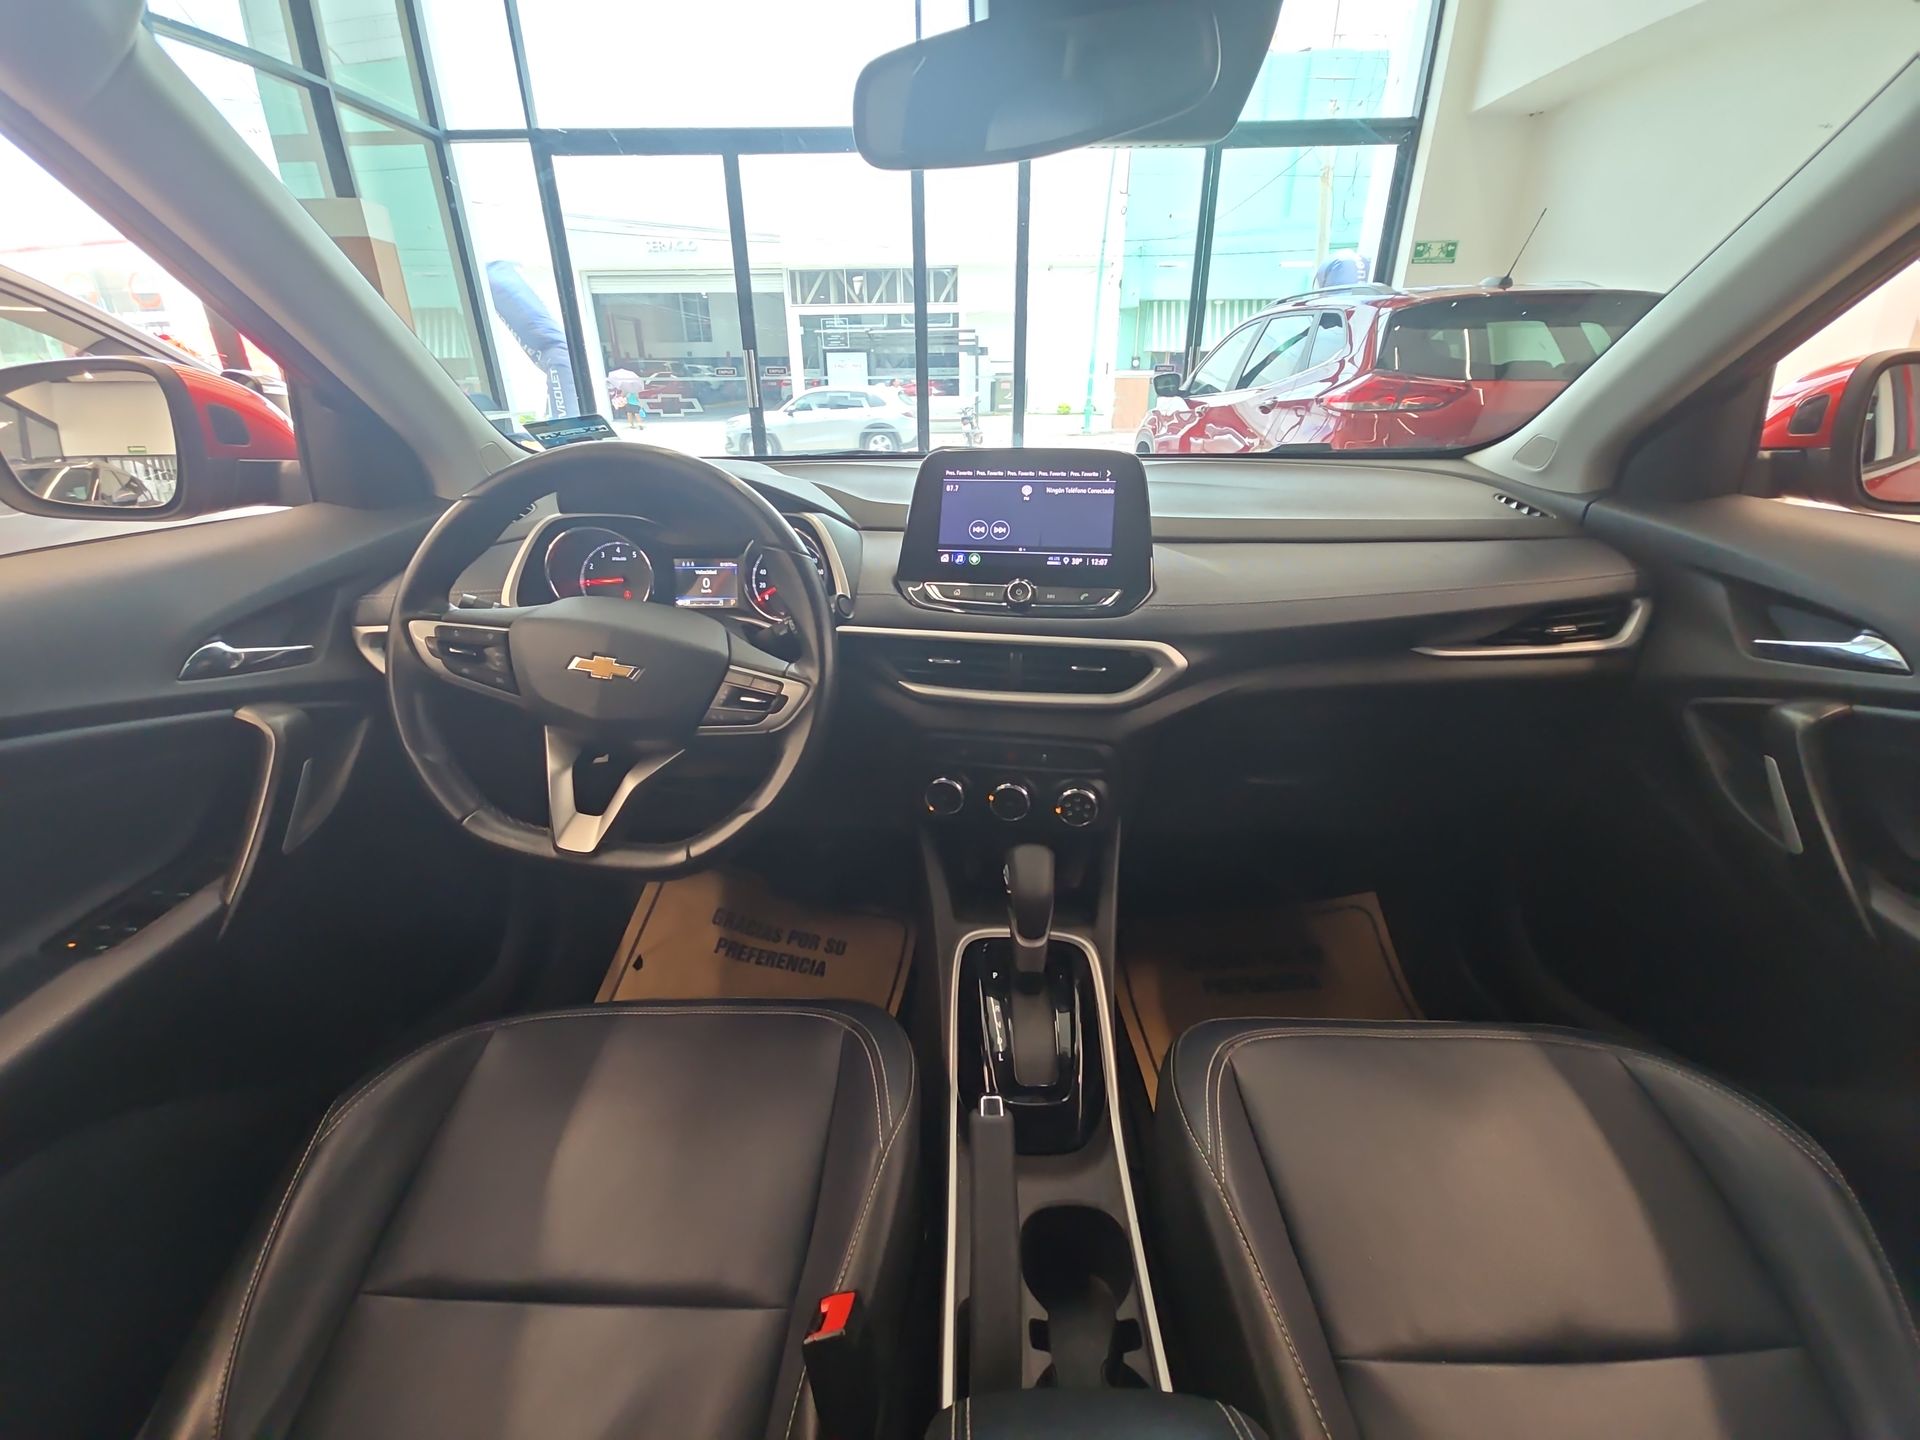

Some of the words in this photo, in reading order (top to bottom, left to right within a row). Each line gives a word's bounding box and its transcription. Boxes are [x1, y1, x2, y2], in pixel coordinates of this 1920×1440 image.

[1087, 487, 1115, 495] Conectado
[1091, 558, 1108, 566] 12:07
[702, 577, 711, 588] 0
[711, 907, 783, 944] GRACIAS
[786, 929, 821, 951] POR
[824, 937, 848, 956] SU
[713, 936, 826, 978] PREFERENCIA
[992, 971, 998, 979] P
[998, 1053, 1004, 1061] L
